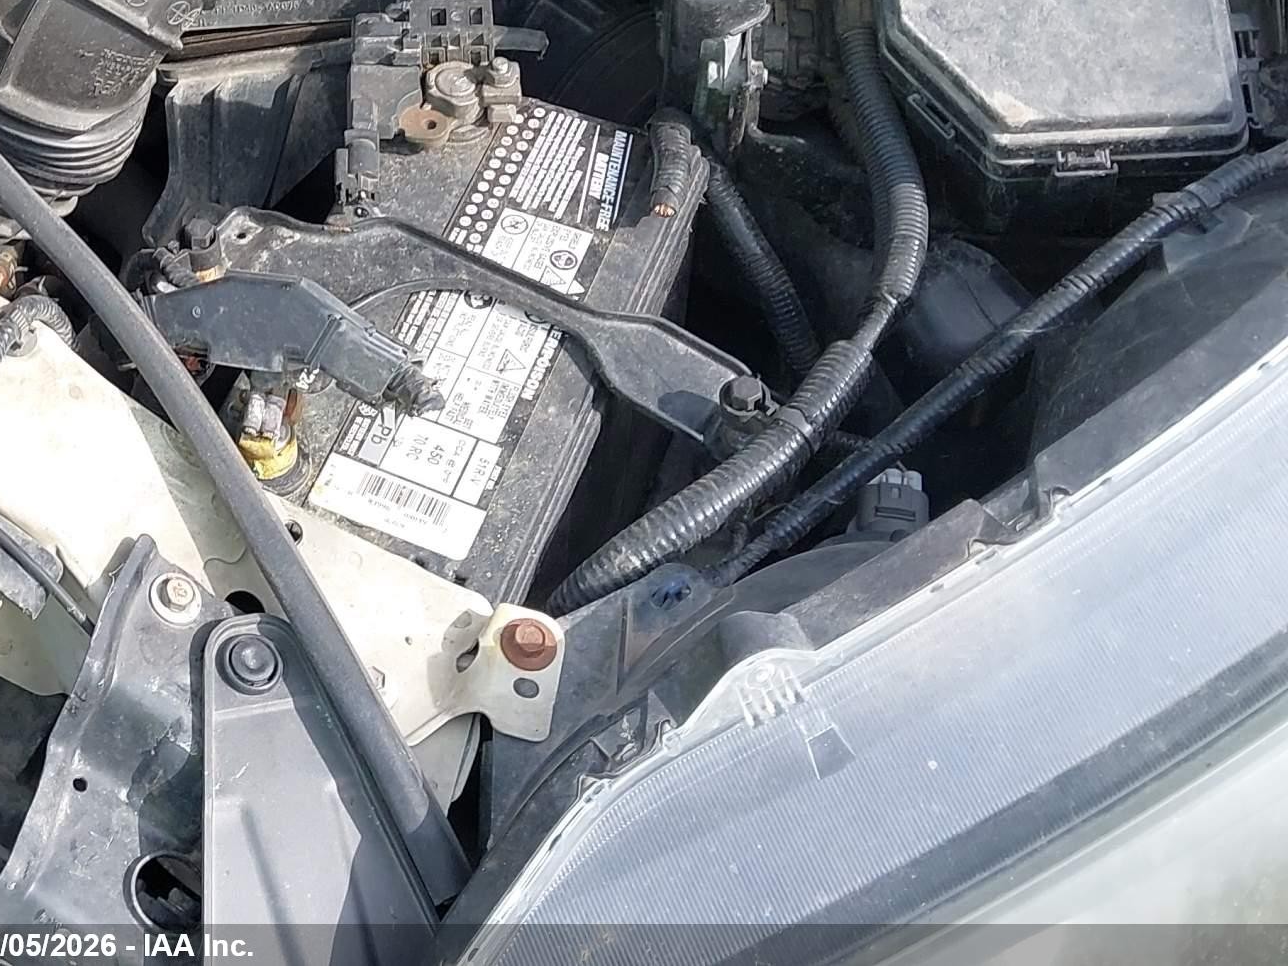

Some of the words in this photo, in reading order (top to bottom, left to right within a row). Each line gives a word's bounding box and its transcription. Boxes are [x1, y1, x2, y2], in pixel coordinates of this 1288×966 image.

[587, 152, 609, 200] BATTERY
[595, 129, 628, 232] MAINTENANCE-FREE
[369, 422, 393, 447] Pb
[404, 444, 423, 462] RC
[425, 443, 446, 467] 450
